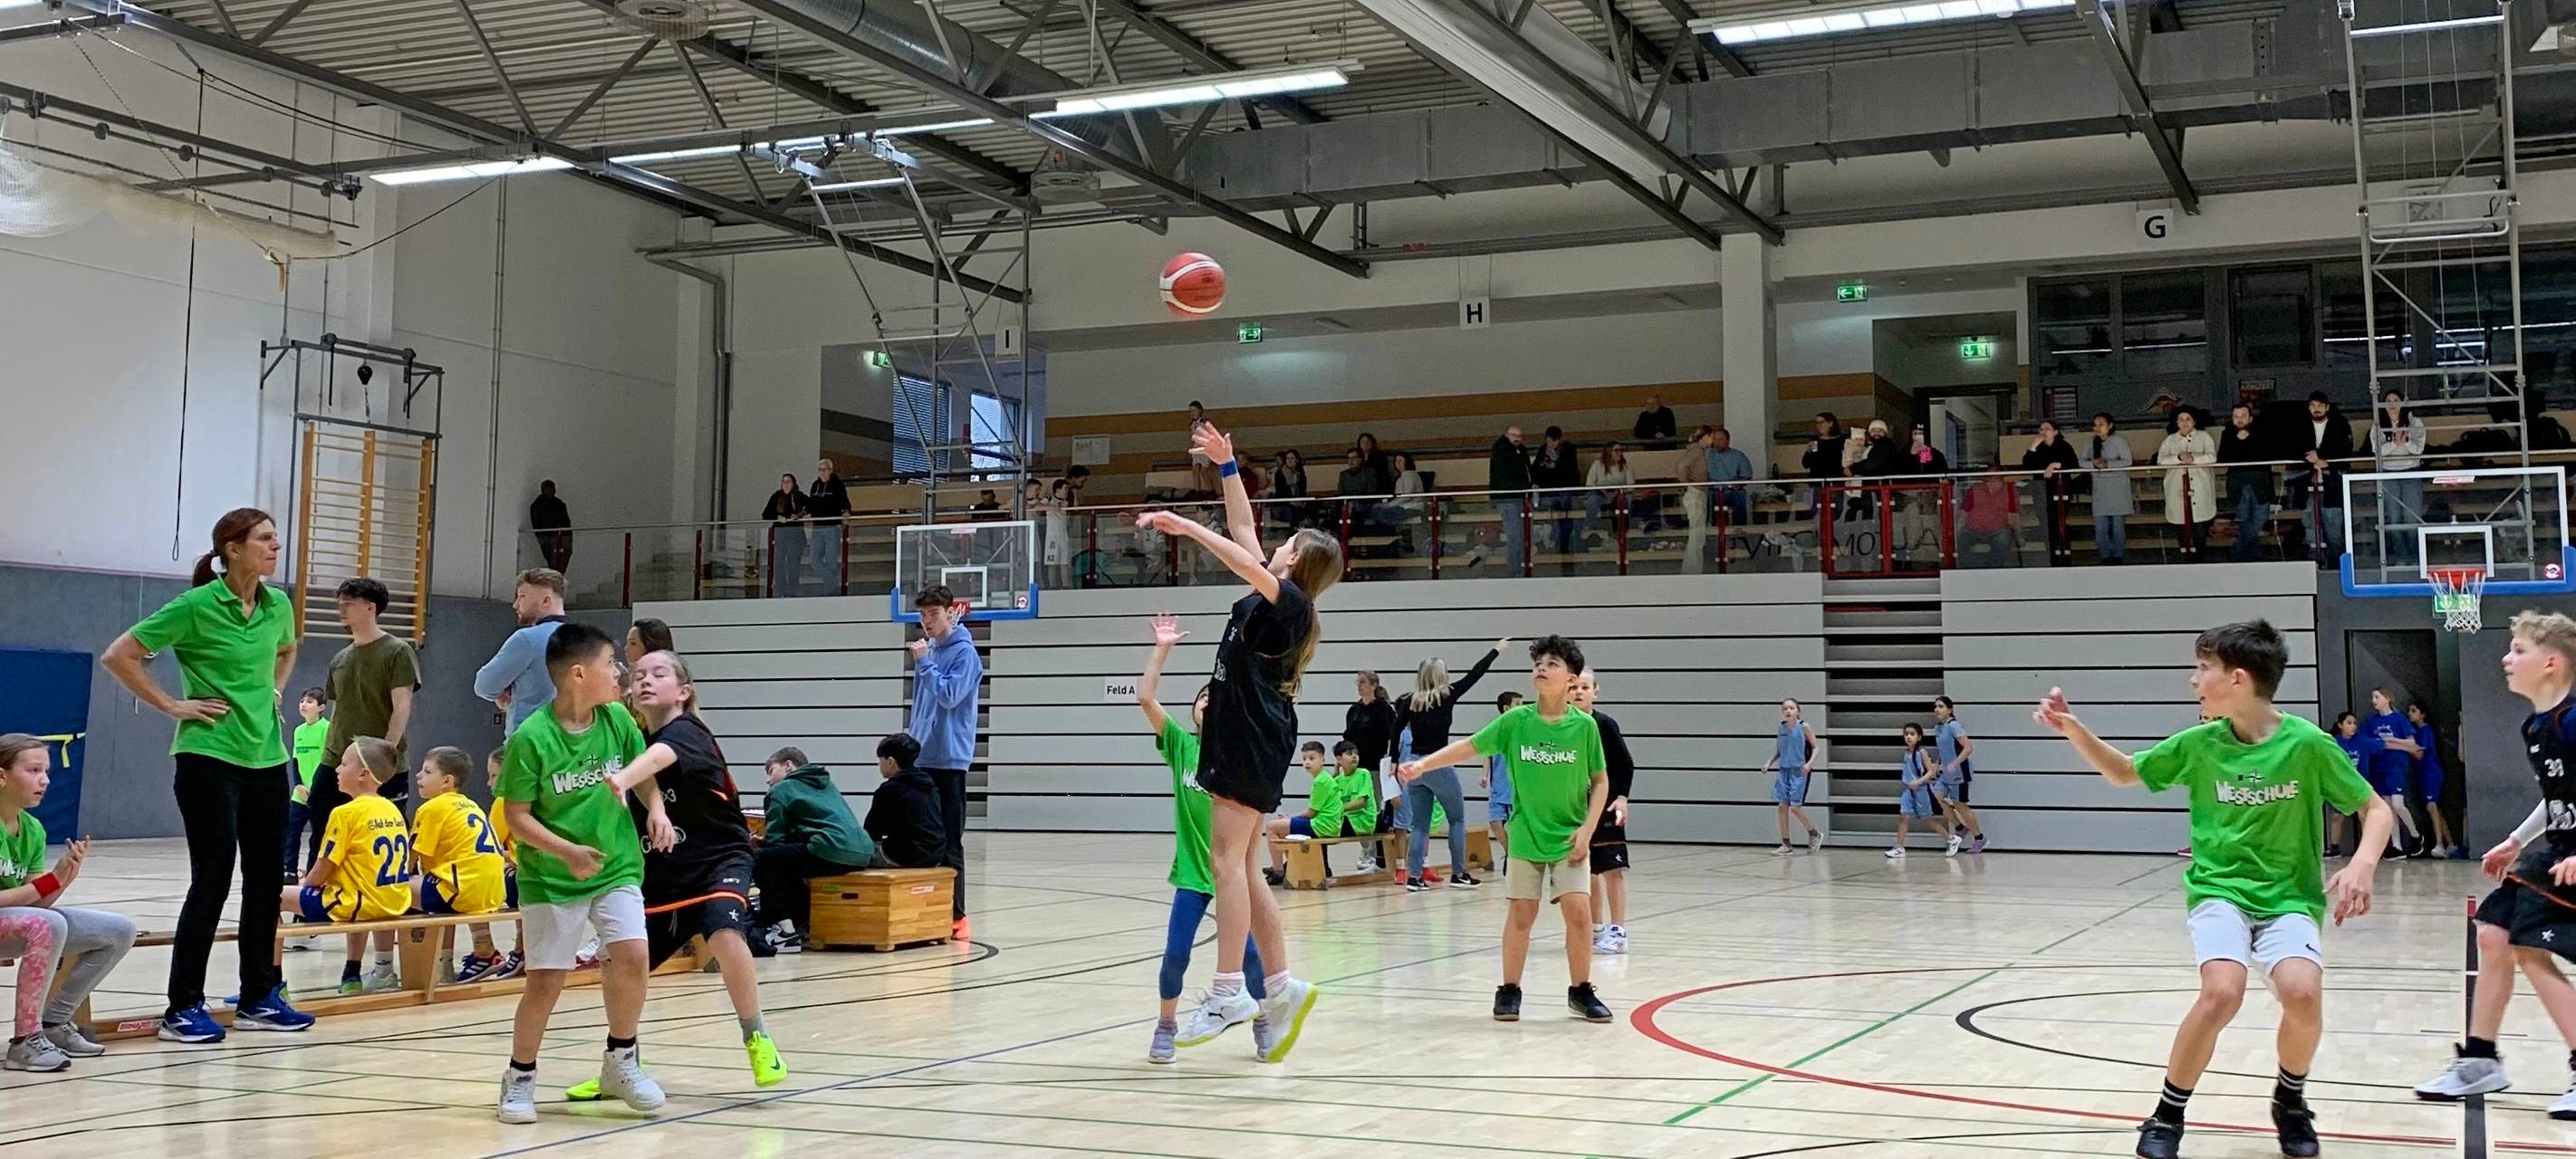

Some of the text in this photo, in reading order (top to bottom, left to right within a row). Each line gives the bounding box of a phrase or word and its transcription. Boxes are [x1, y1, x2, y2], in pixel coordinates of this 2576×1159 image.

[2144, 215, 2166, 238] G
[1466, 302, 1483, 323] H
[1005, 330, 1009, 348] I
[1107, 685, 1135, 694] Feld A
[1520, 745, 1577, 765] WESTSCHULE
[2216, 781, 2299, 806] WESTSCHULE
[466, 813, 504, 857] 2
[373, 834, 409, 886] 22
